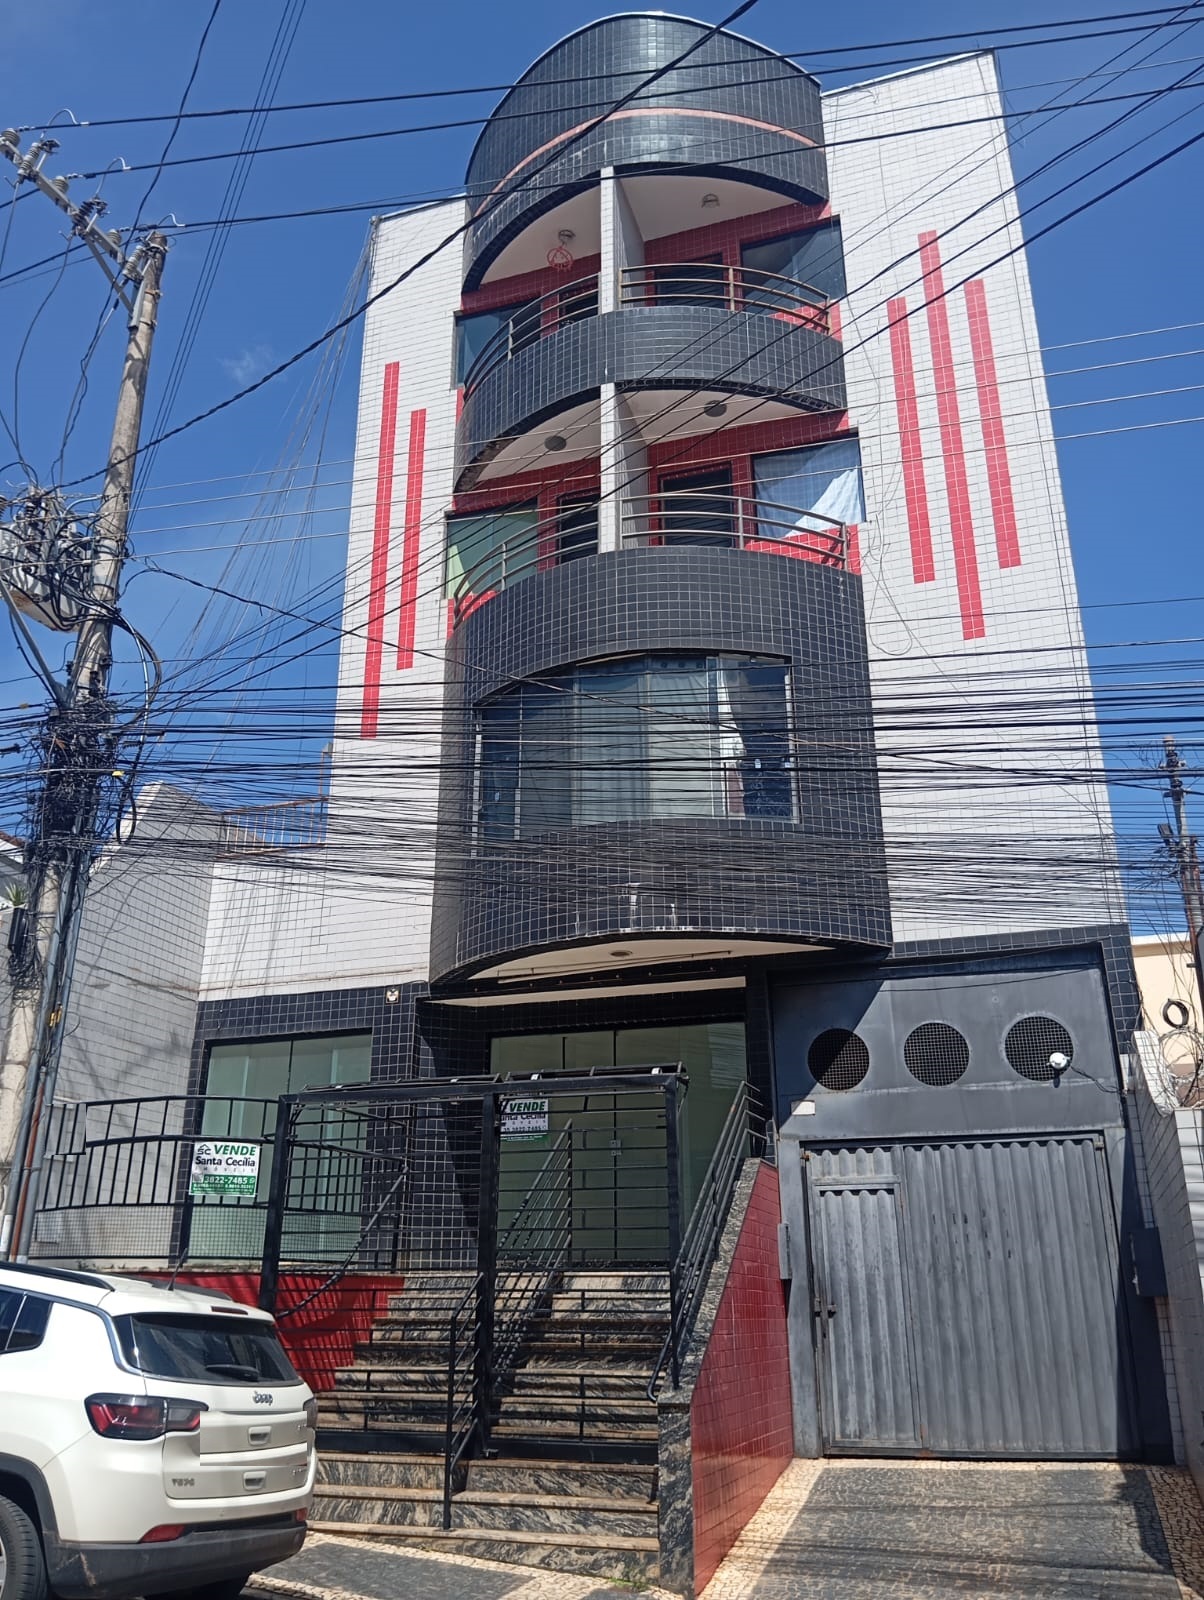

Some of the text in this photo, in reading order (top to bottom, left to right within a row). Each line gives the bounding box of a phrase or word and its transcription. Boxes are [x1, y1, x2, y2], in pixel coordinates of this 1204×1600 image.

[509, 1101, 546, 1112] VENDE
[214, 1144, 257, 1156] VENDE
[195, 1155, 223, 1166] Santa
